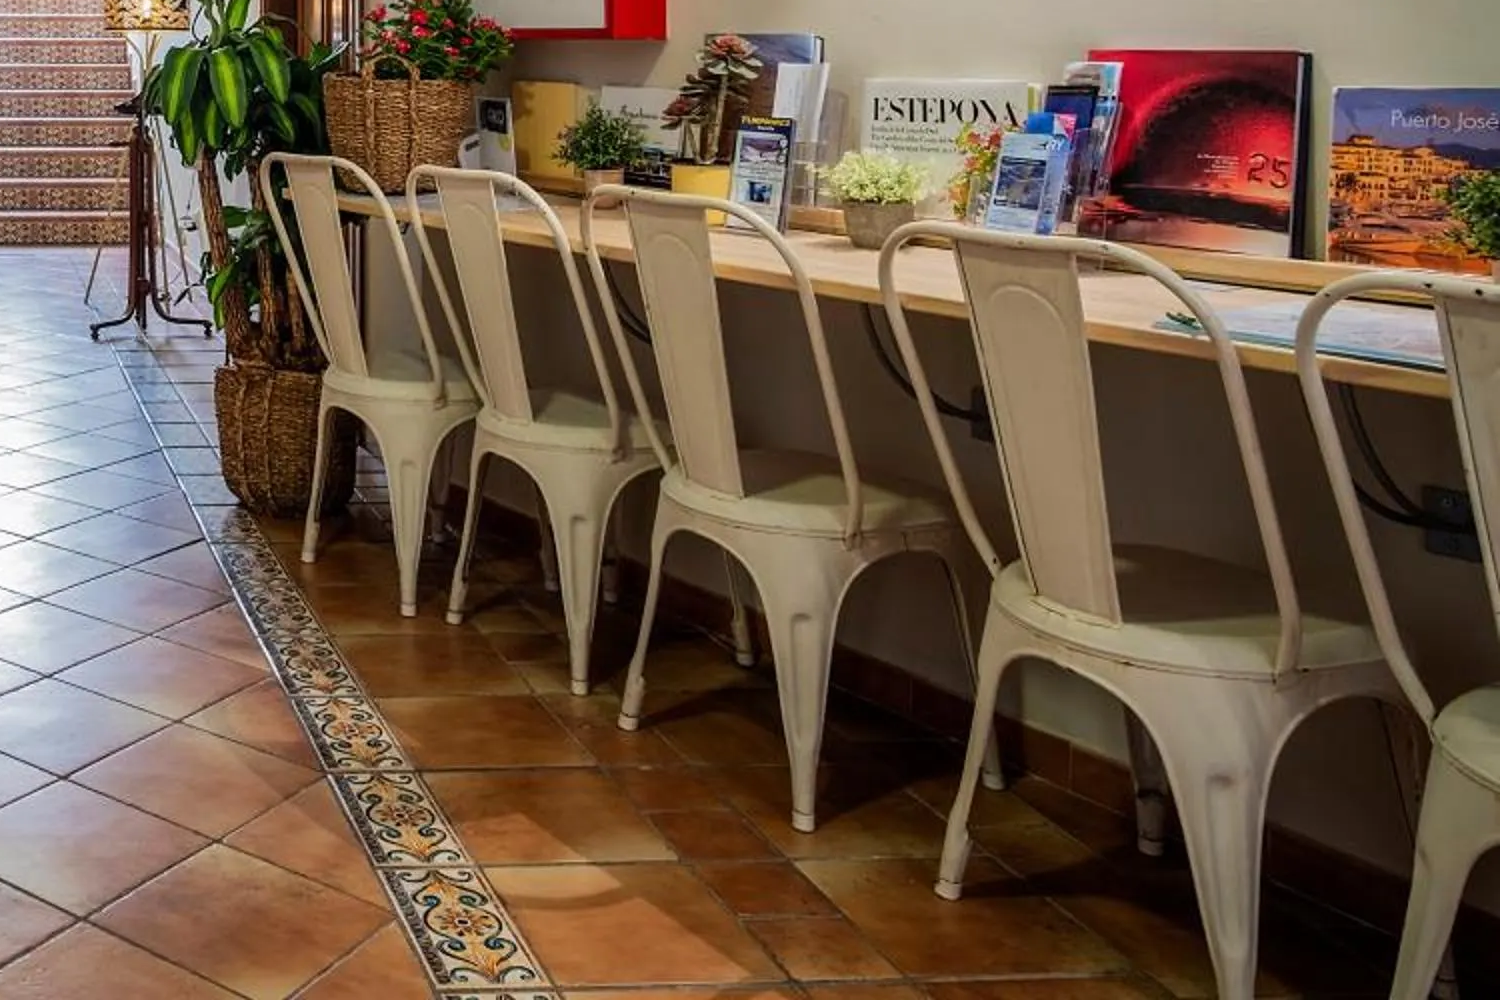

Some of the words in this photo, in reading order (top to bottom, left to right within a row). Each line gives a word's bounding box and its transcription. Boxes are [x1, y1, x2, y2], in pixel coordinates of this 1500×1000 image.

[873, 97, 1020, 127] ESTEPONA
[1390, 108, 1451, 129] Puerto
[1453, 111, 1499, 133] José
[1247, 152, 1291, 189] 25
